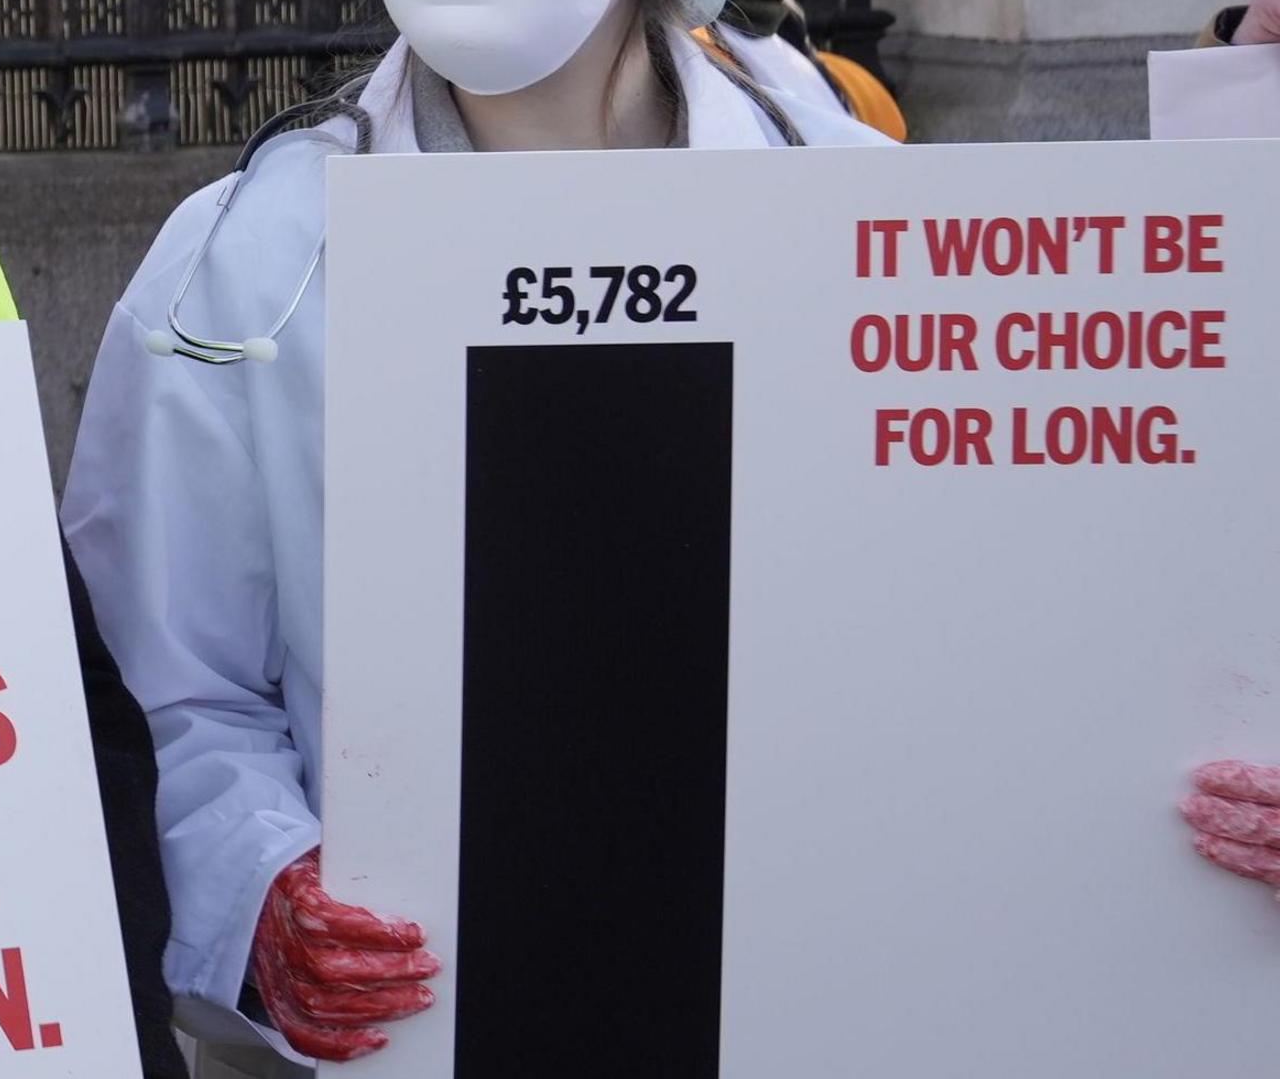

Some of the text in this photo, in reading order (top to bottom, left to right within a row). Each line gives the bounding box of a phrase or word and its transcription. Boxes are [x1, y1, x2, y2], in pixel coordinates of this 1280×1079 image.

[854, 214, 1225, 278] IT WON'T BE
[501, 264, 698, 336] £5,782
[851, 310, 1226, 373] OUR CHOICE
[874, 405, 1197, 467] FOR LONG.
